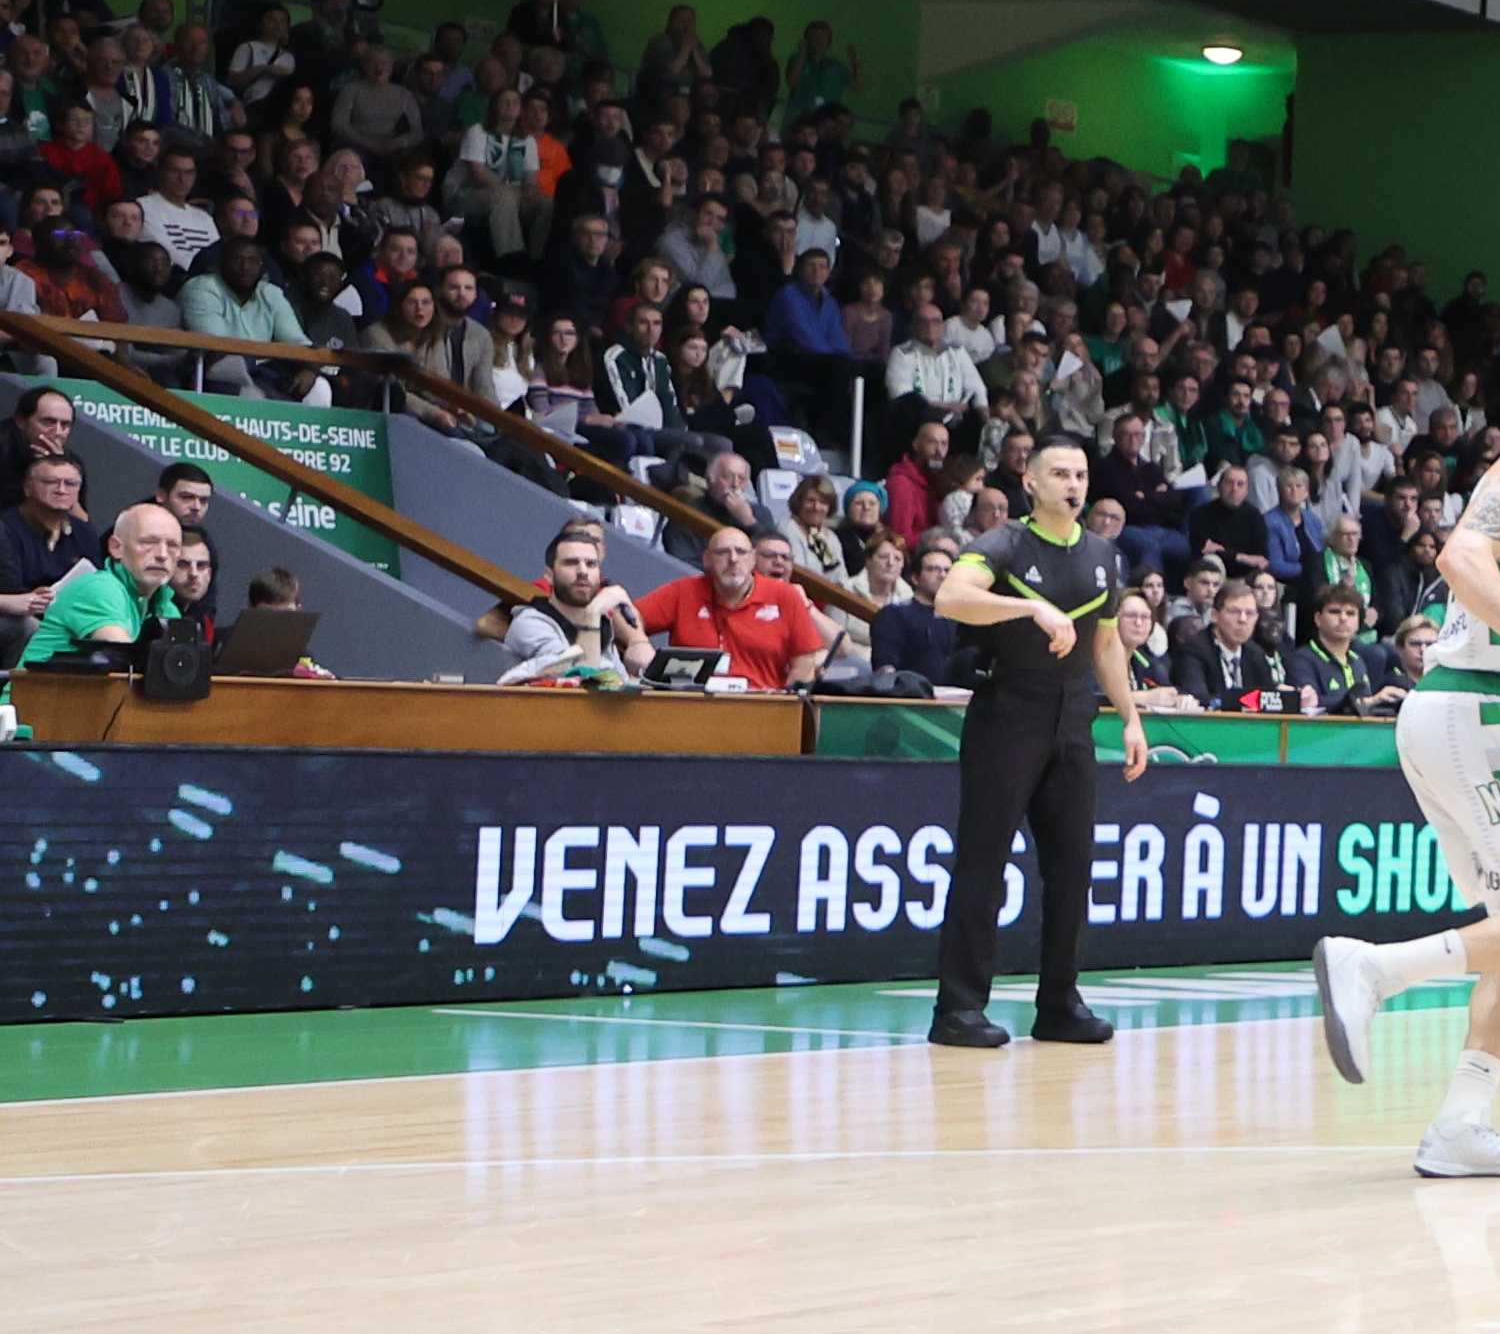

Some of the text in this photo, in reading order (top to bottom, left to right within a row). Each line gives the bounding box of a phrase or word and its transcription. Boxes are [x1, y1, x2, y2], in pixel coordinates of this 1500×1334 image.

[235, 415, 377, 450] HAUTS-DE-SEINE
[160, 435, 351, 473] LE CLUB 92
[474, 791, 1322, 945] VENEZ ASSER À UN
